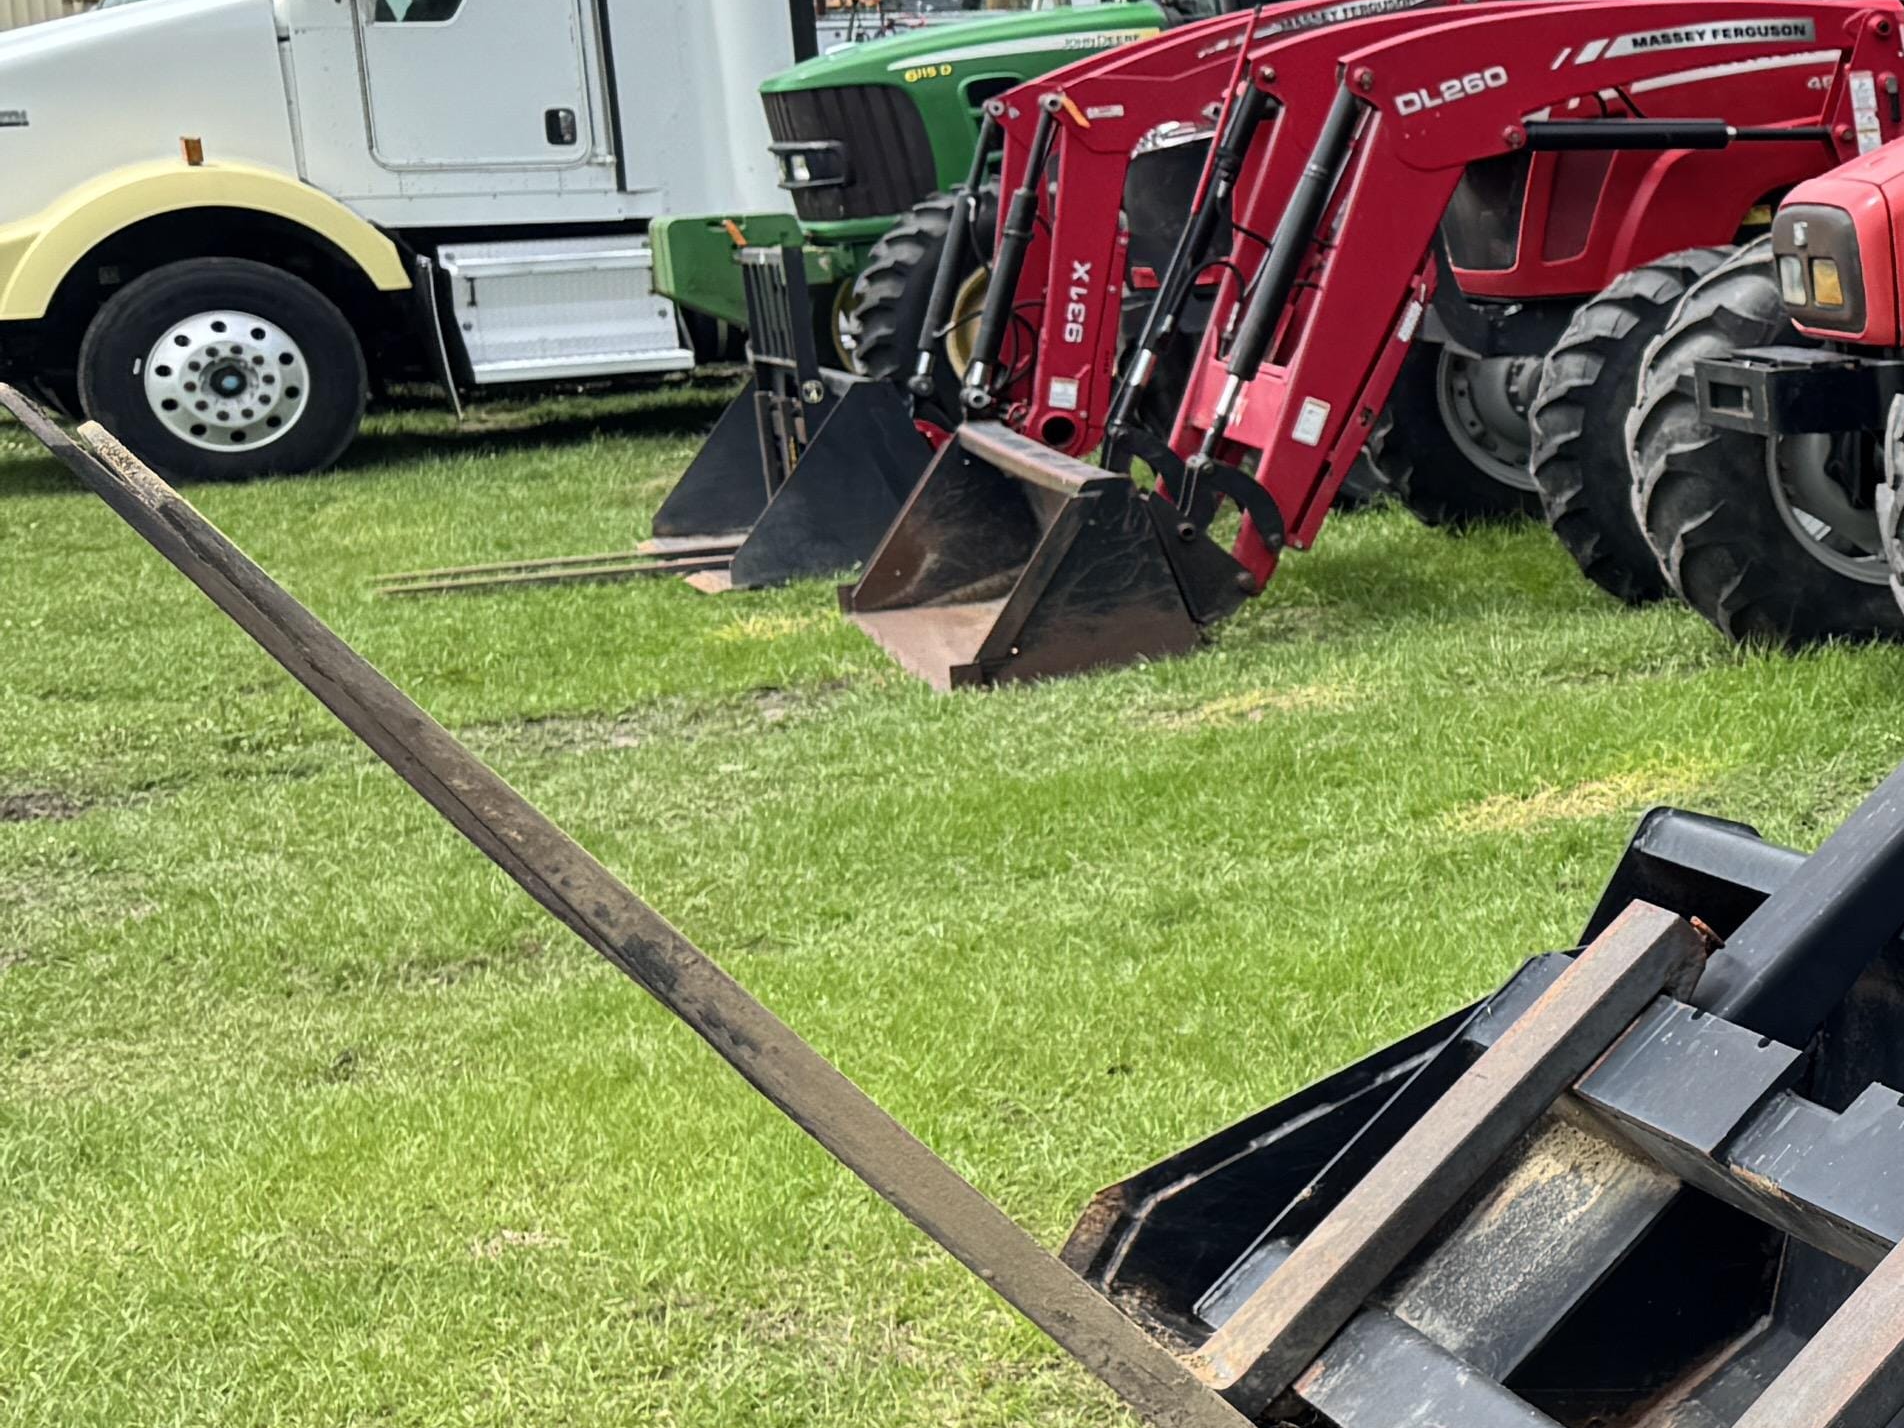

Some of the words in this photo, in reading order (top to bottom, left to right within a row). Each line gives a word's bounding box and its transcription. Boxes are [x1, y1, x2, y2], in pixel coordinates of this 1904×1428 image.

[1632, 29, 1706, 48] MASSEY
[1711, 24, 1807, 41] FERGUSON
[1394, 65, 1509, 116] DL260
[1064, 260, 1092, 343] 931X
